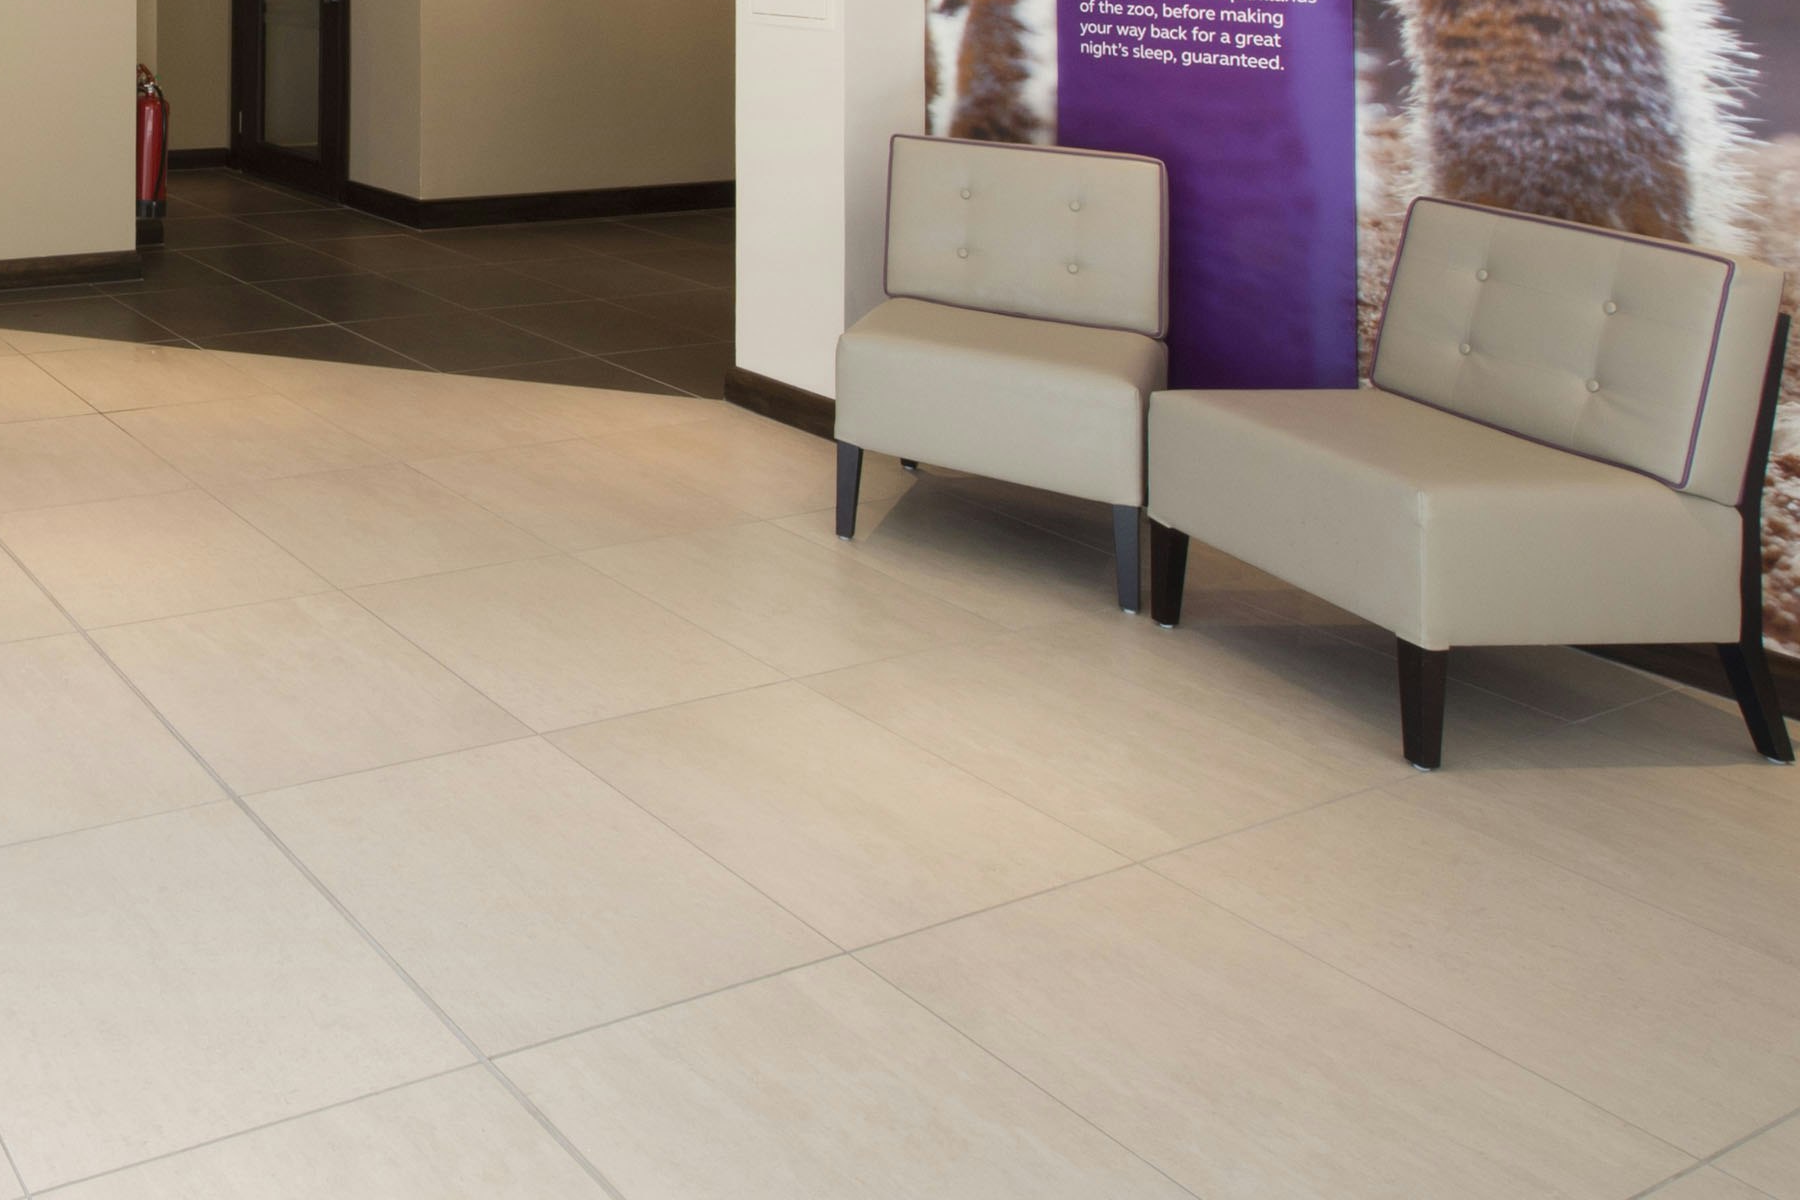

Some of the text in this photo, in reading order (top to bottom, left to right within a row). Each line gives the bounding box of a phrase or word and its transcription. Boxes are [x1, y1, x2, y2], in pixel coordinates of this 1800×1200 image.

[1080, 0, 1284, 28] of the zoo, before making
[1080, 22, 1282, 48] your way back for a great
[1080, 41, 1285, 70] night's sleep, guaranteed.
